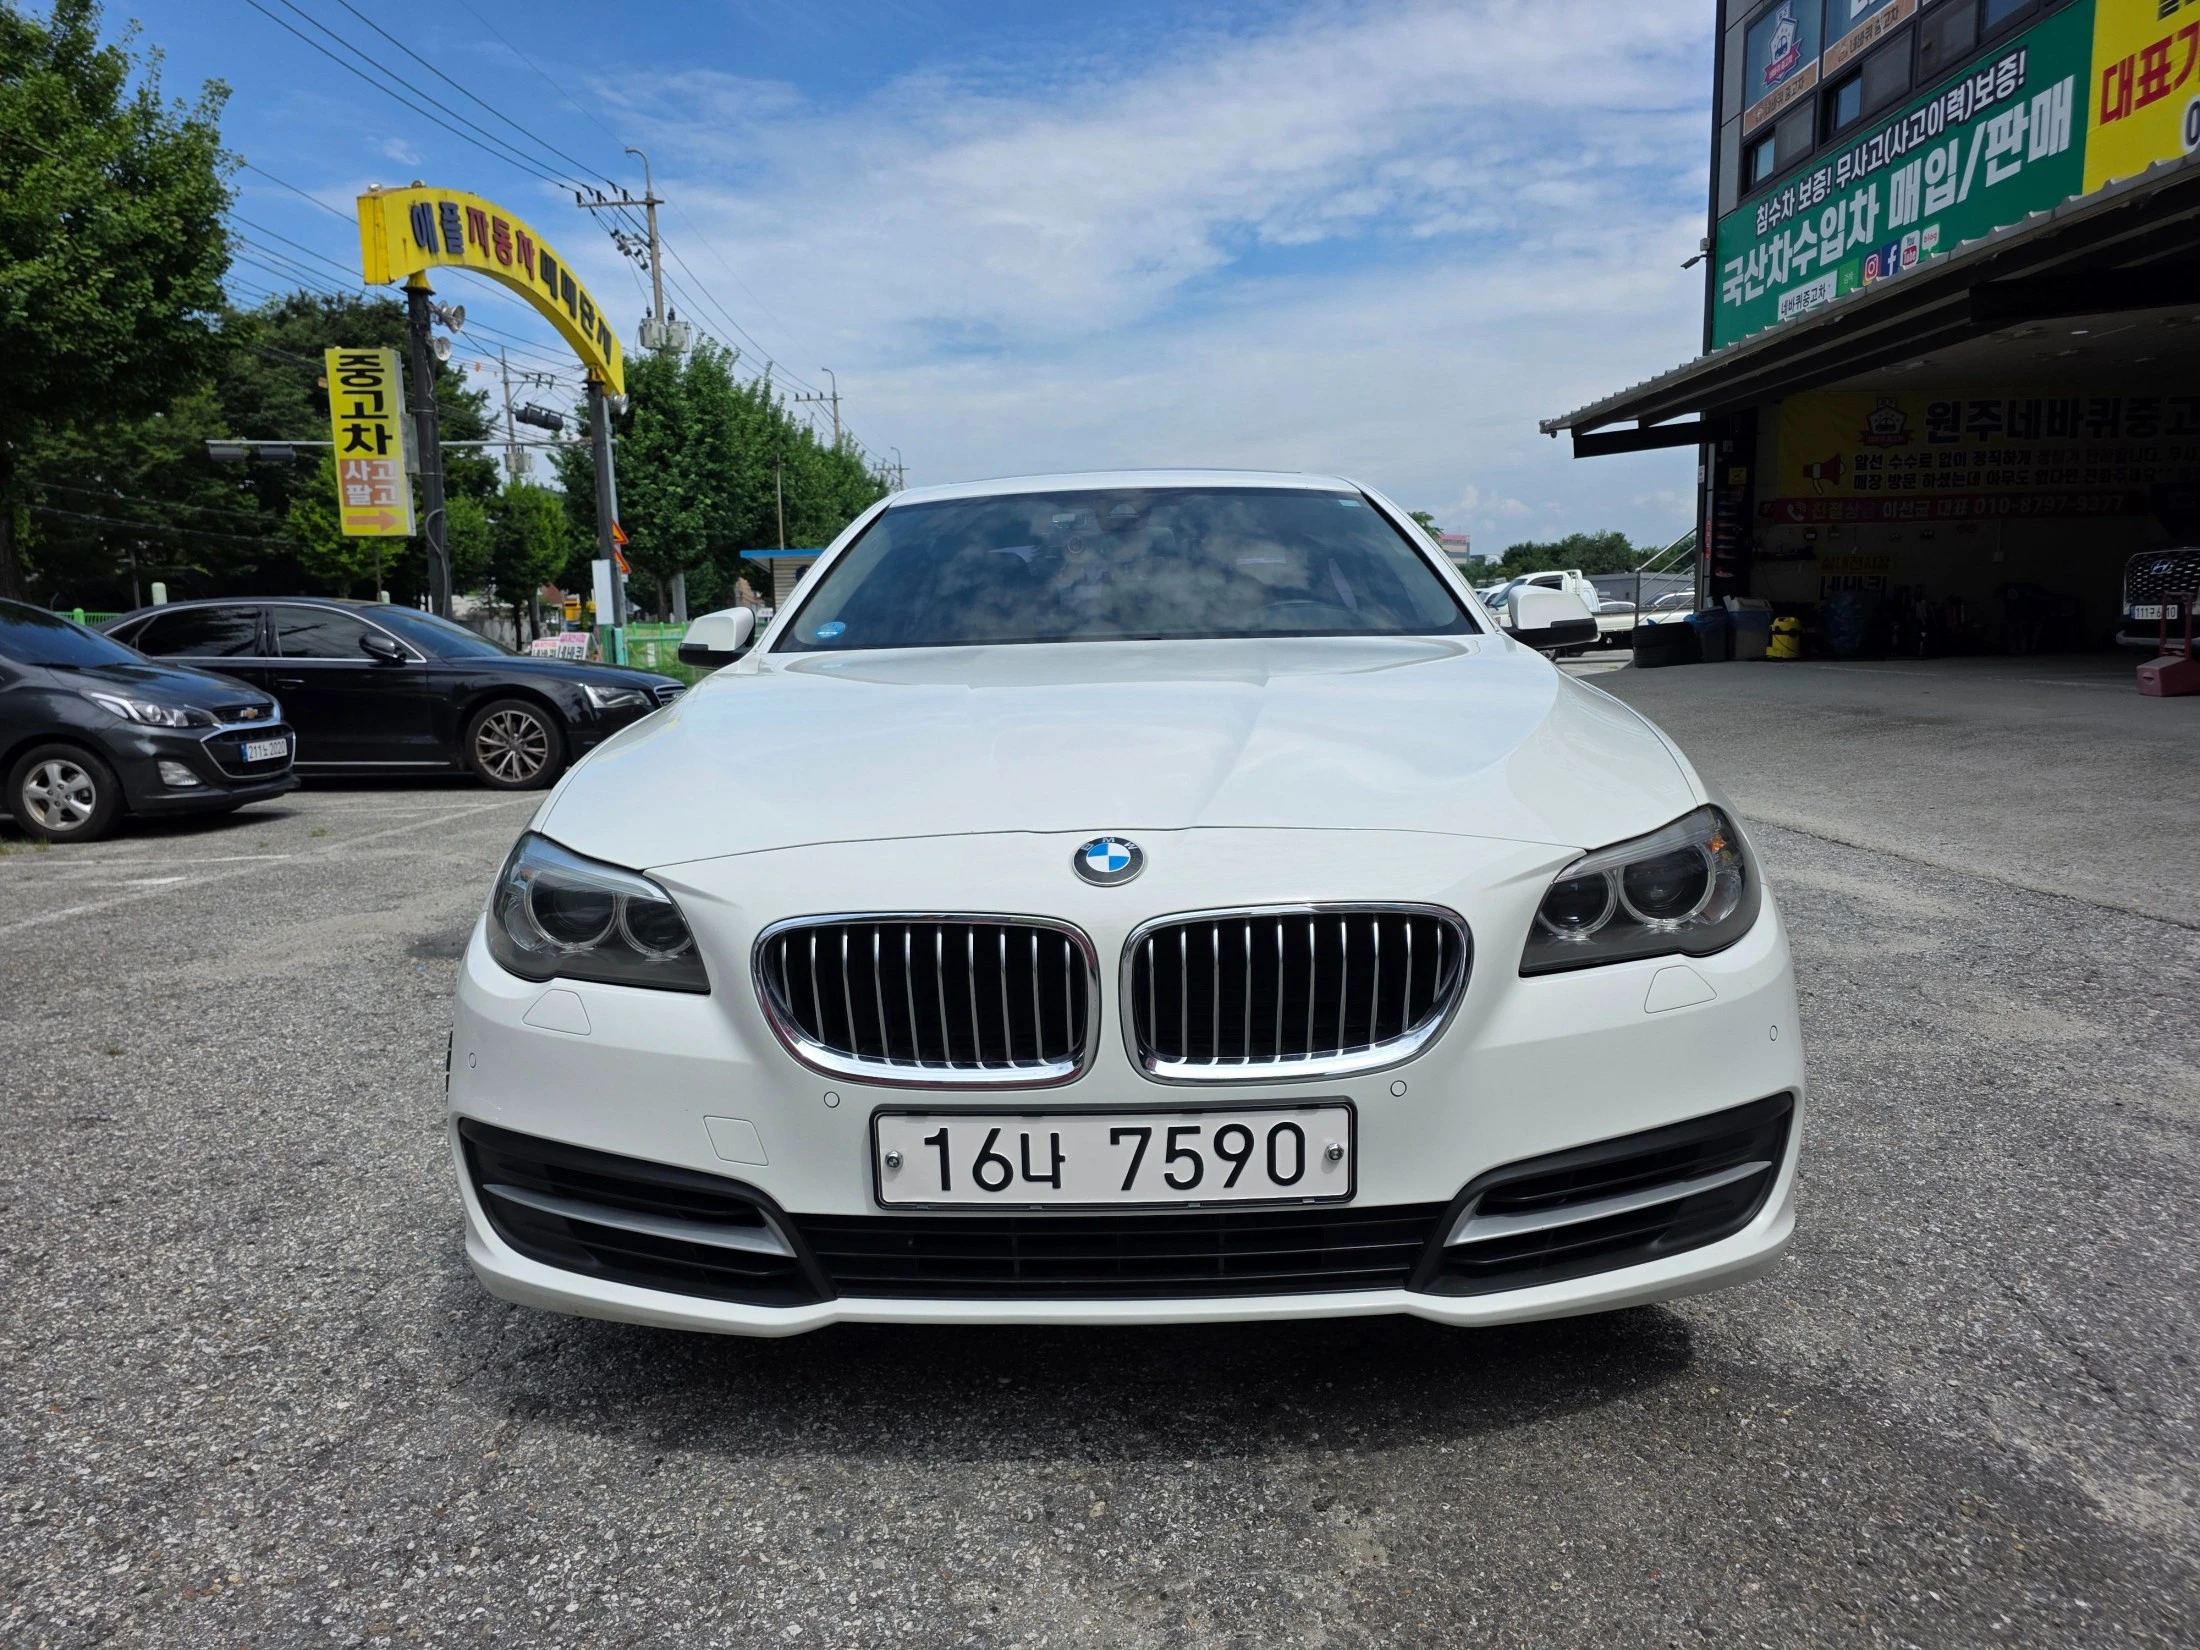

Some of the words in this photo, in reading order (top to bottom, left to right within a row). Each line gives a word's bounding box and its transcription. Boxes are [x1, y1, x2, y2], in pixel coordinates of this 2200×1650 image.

[1756, 188, 1795, 236] 침수차
[1798, 167, 1831, 211] 보증!
[1836, 50, 2026, 188] 무사고(사고이력)보증!
[1722, 183, 1880, 307] 국산차수입차
[1888, 74, 2074, 230] 매입/판매
[1780, 283, 1826, 316] 네바퀴중고차
[336, 354, 393, 455] 중고차
[344, 460, 398, 482] 사고
[1854, 454, 1884, 470] 알선
[1889, 453, 1933, 469] 수수료
[1939, 451, 1967, 468] 없이
[1854, 473, 1882, 490] 매장
[1888, 473, 1917, 490] 방문
[1922, 471, 1981, 488] 하셨는데
[1986, 469, 2030, 486] 아무도
[346, 483, 399, 507] 팔고
[1936, 498, 1969, 516] 대표
[1080, 837, 1138, 851] BMW
[923, 1127, 1066, 1193] 16나
[1109, 1121, 1307, 1192] 7590
